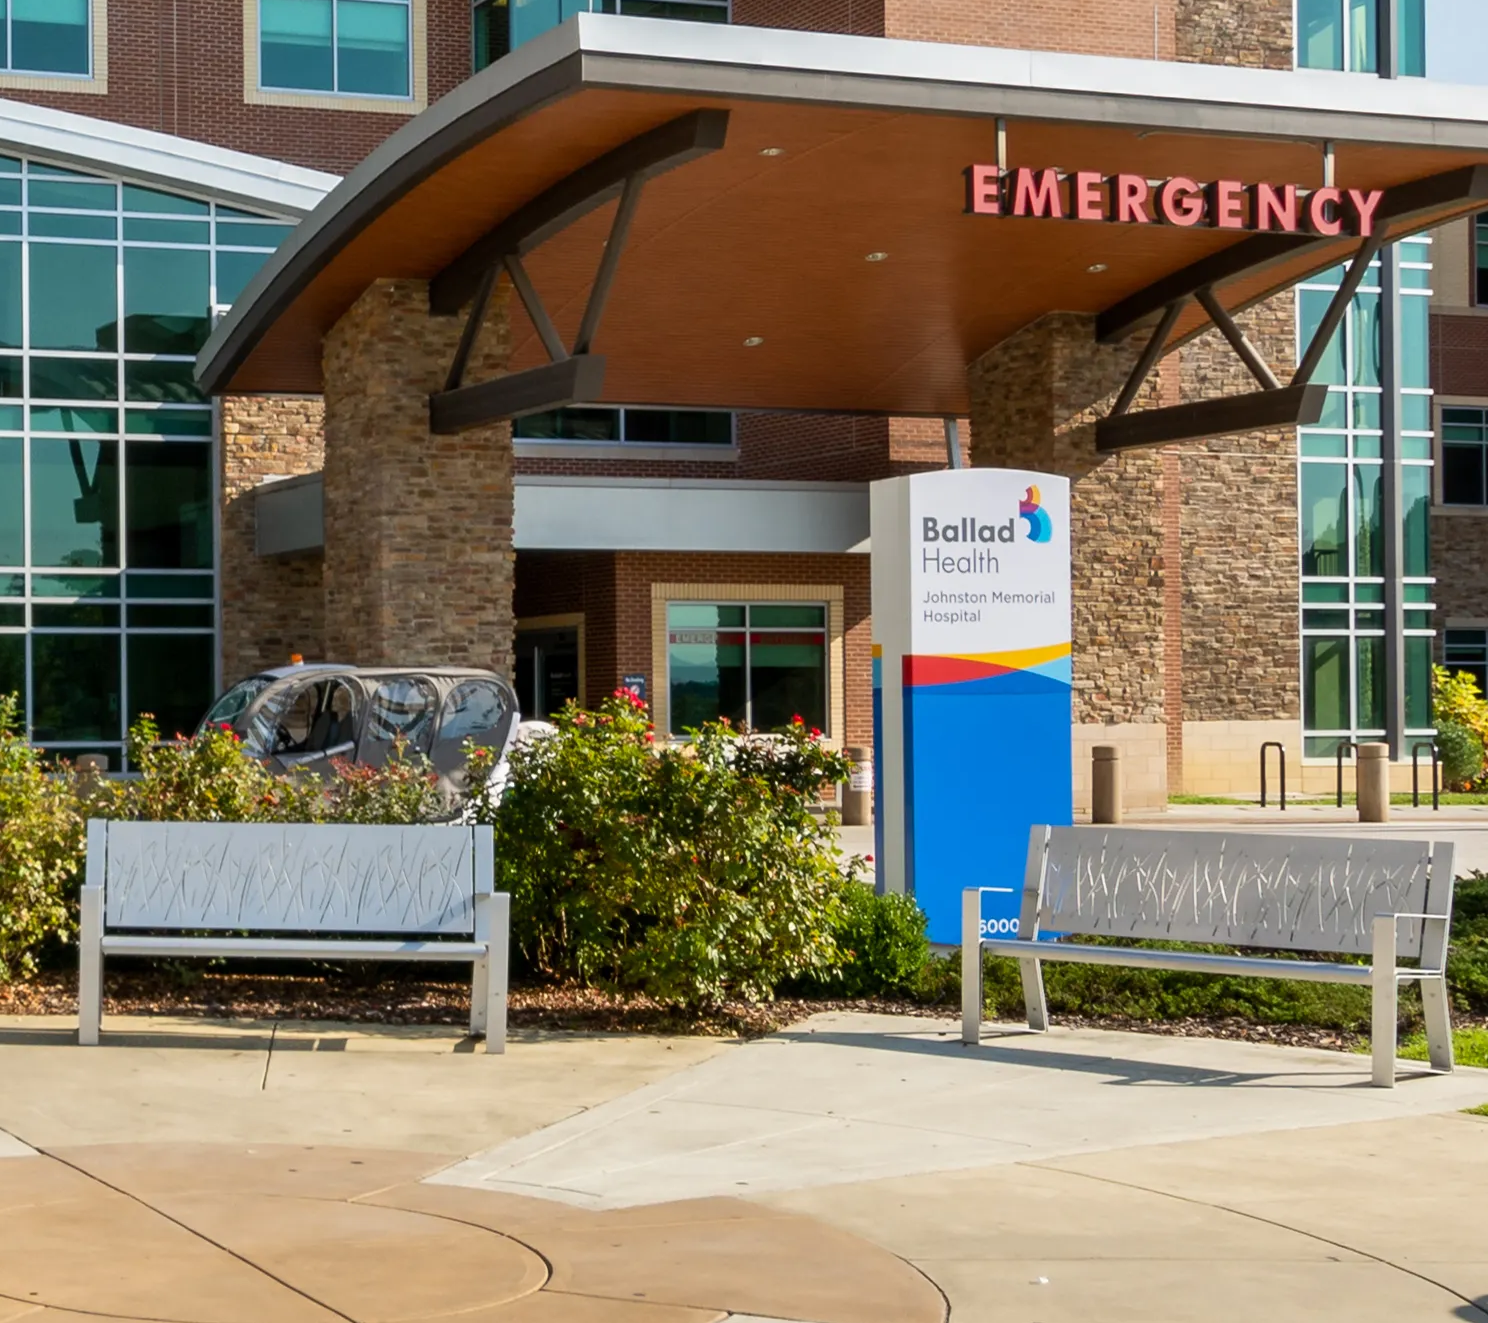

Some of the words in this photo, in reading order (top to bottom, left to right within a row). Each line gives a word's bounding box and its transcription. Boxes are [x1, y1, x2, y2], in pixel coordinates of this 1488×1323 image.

[968, 163, 1385, 238] EMERGENCY
[922, 516, 1015, 544] Ballad
[922, 547, 1000, 574] Health
[922, 591, 987, 604] Johnston
[991, 591, 1056, 604] Memorial
[923, 609, 981, 625] Hospital
